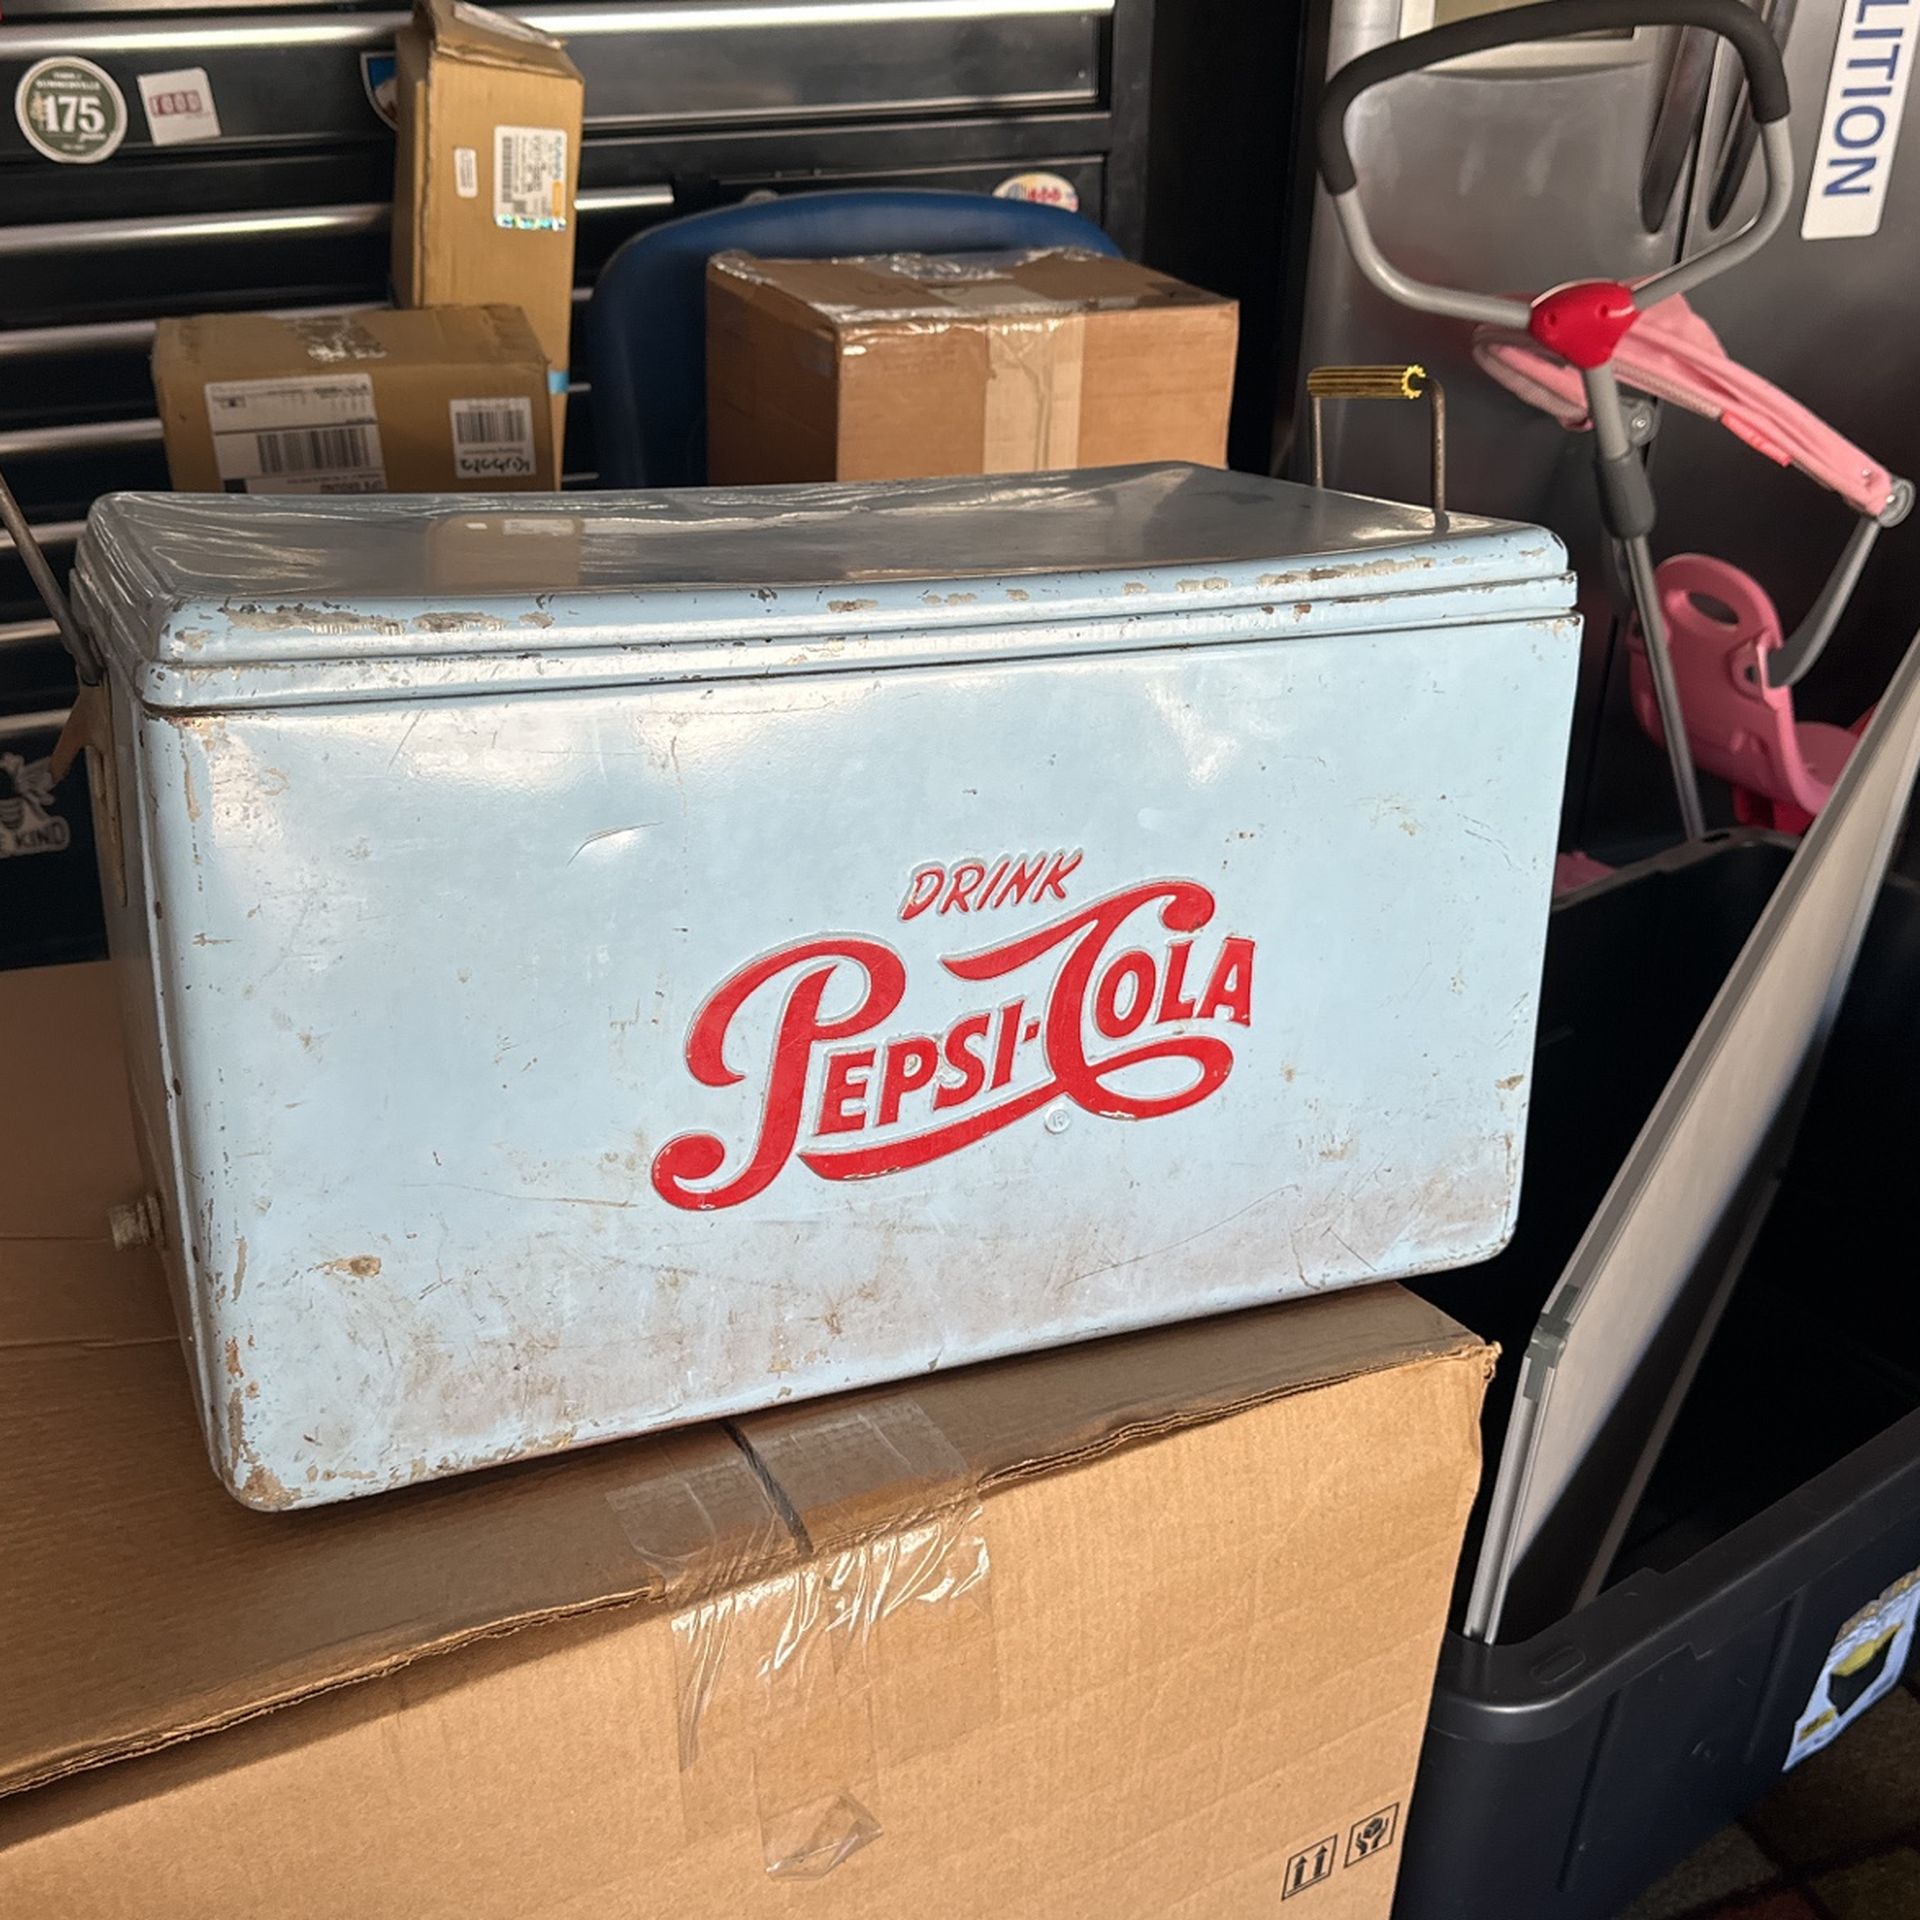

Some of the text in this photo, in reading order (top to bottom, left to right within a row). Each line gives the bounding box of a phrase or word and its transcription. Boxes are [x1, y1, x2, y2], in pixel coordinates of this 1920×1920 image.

[44, 95, 106, 133] 175
[1823, 0, 1910, 196] LITION
[902, 853, 1084, 921] DRINK
